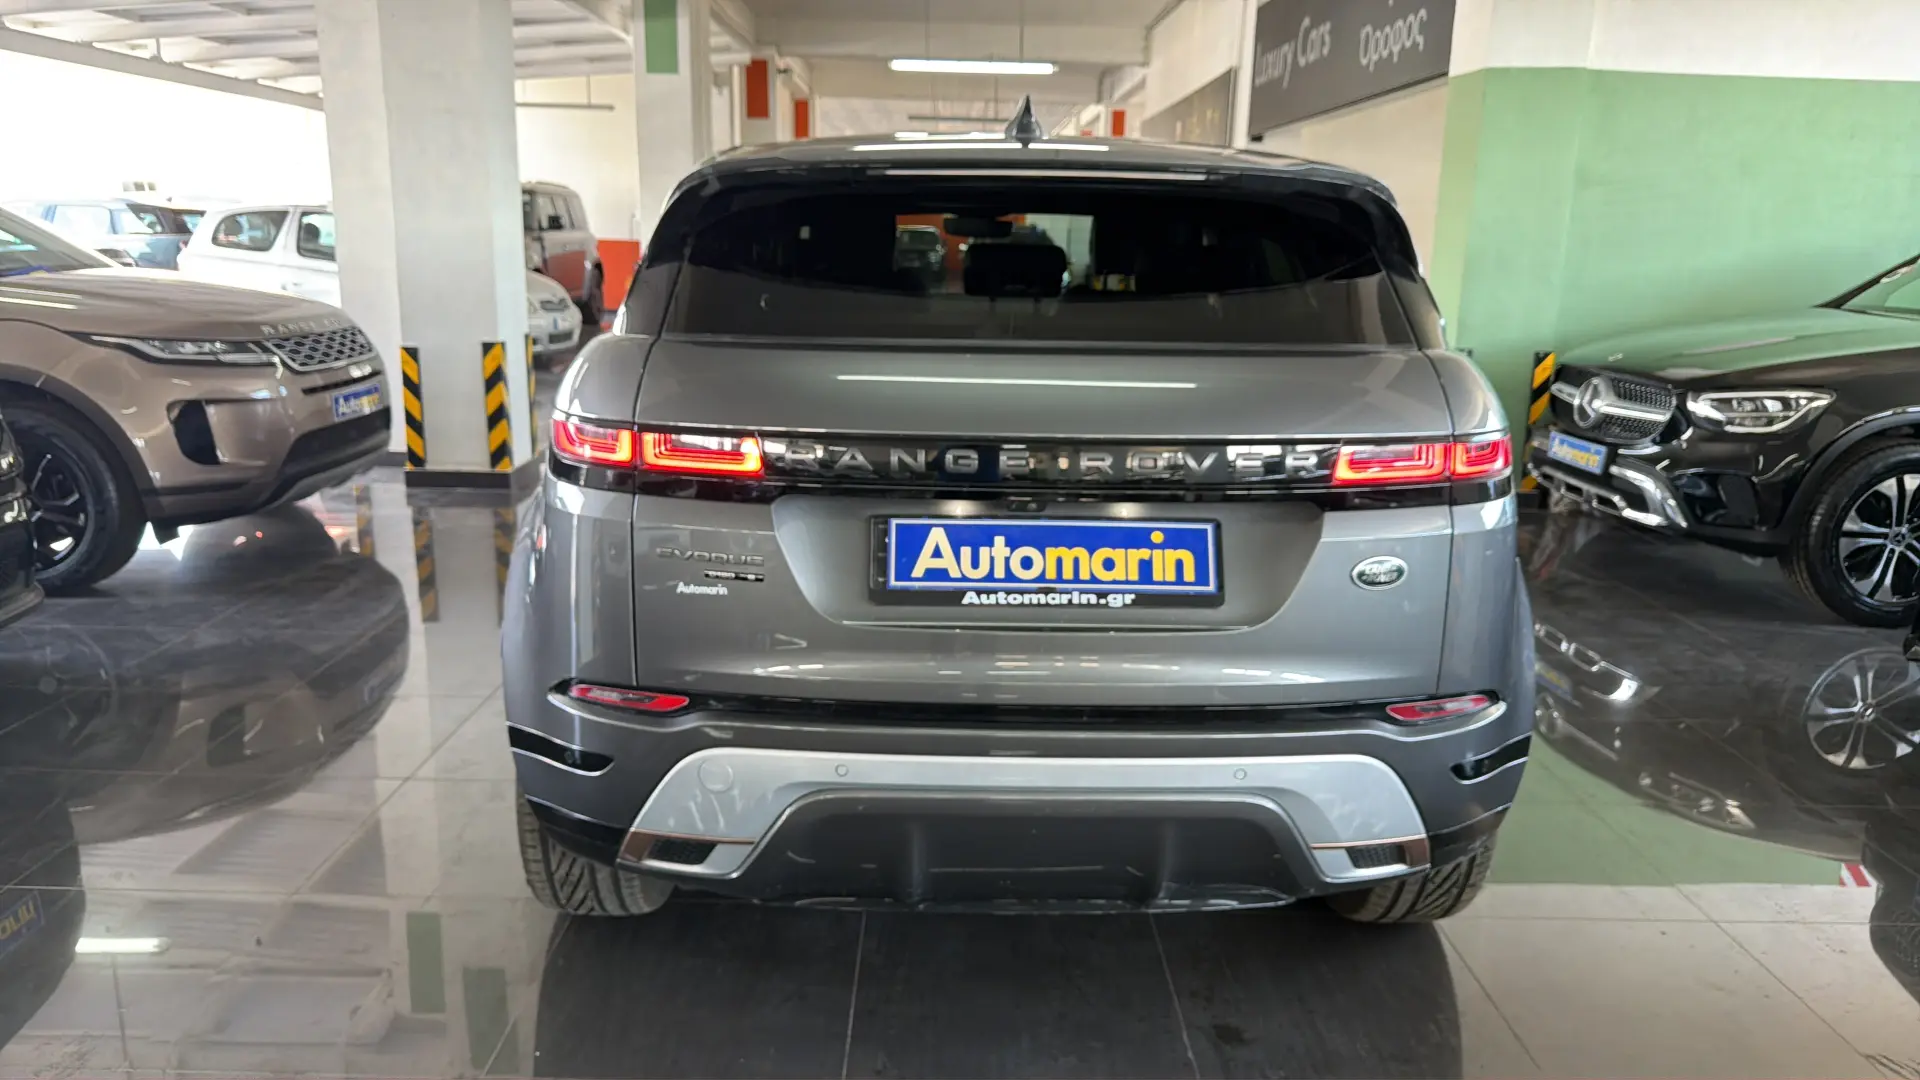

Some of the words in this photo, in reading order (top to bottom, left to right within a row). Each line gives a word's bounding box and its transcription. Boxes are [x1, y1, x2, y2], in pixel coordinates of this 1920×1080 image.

[1254, 41, 1296, 89] Luxury
[1297, 16, 1332, 67] Cars
[783, 442, 1031, 474] RANGE
[1079, 450, 1319, 475] ROVER
[656, 547, 765, 566] EVOQUE
[911, 526, 1196, 582] Automarin
[675, 581, 729, 596] Automarin
[961, 590, 1136, 607] Automarin.gr
